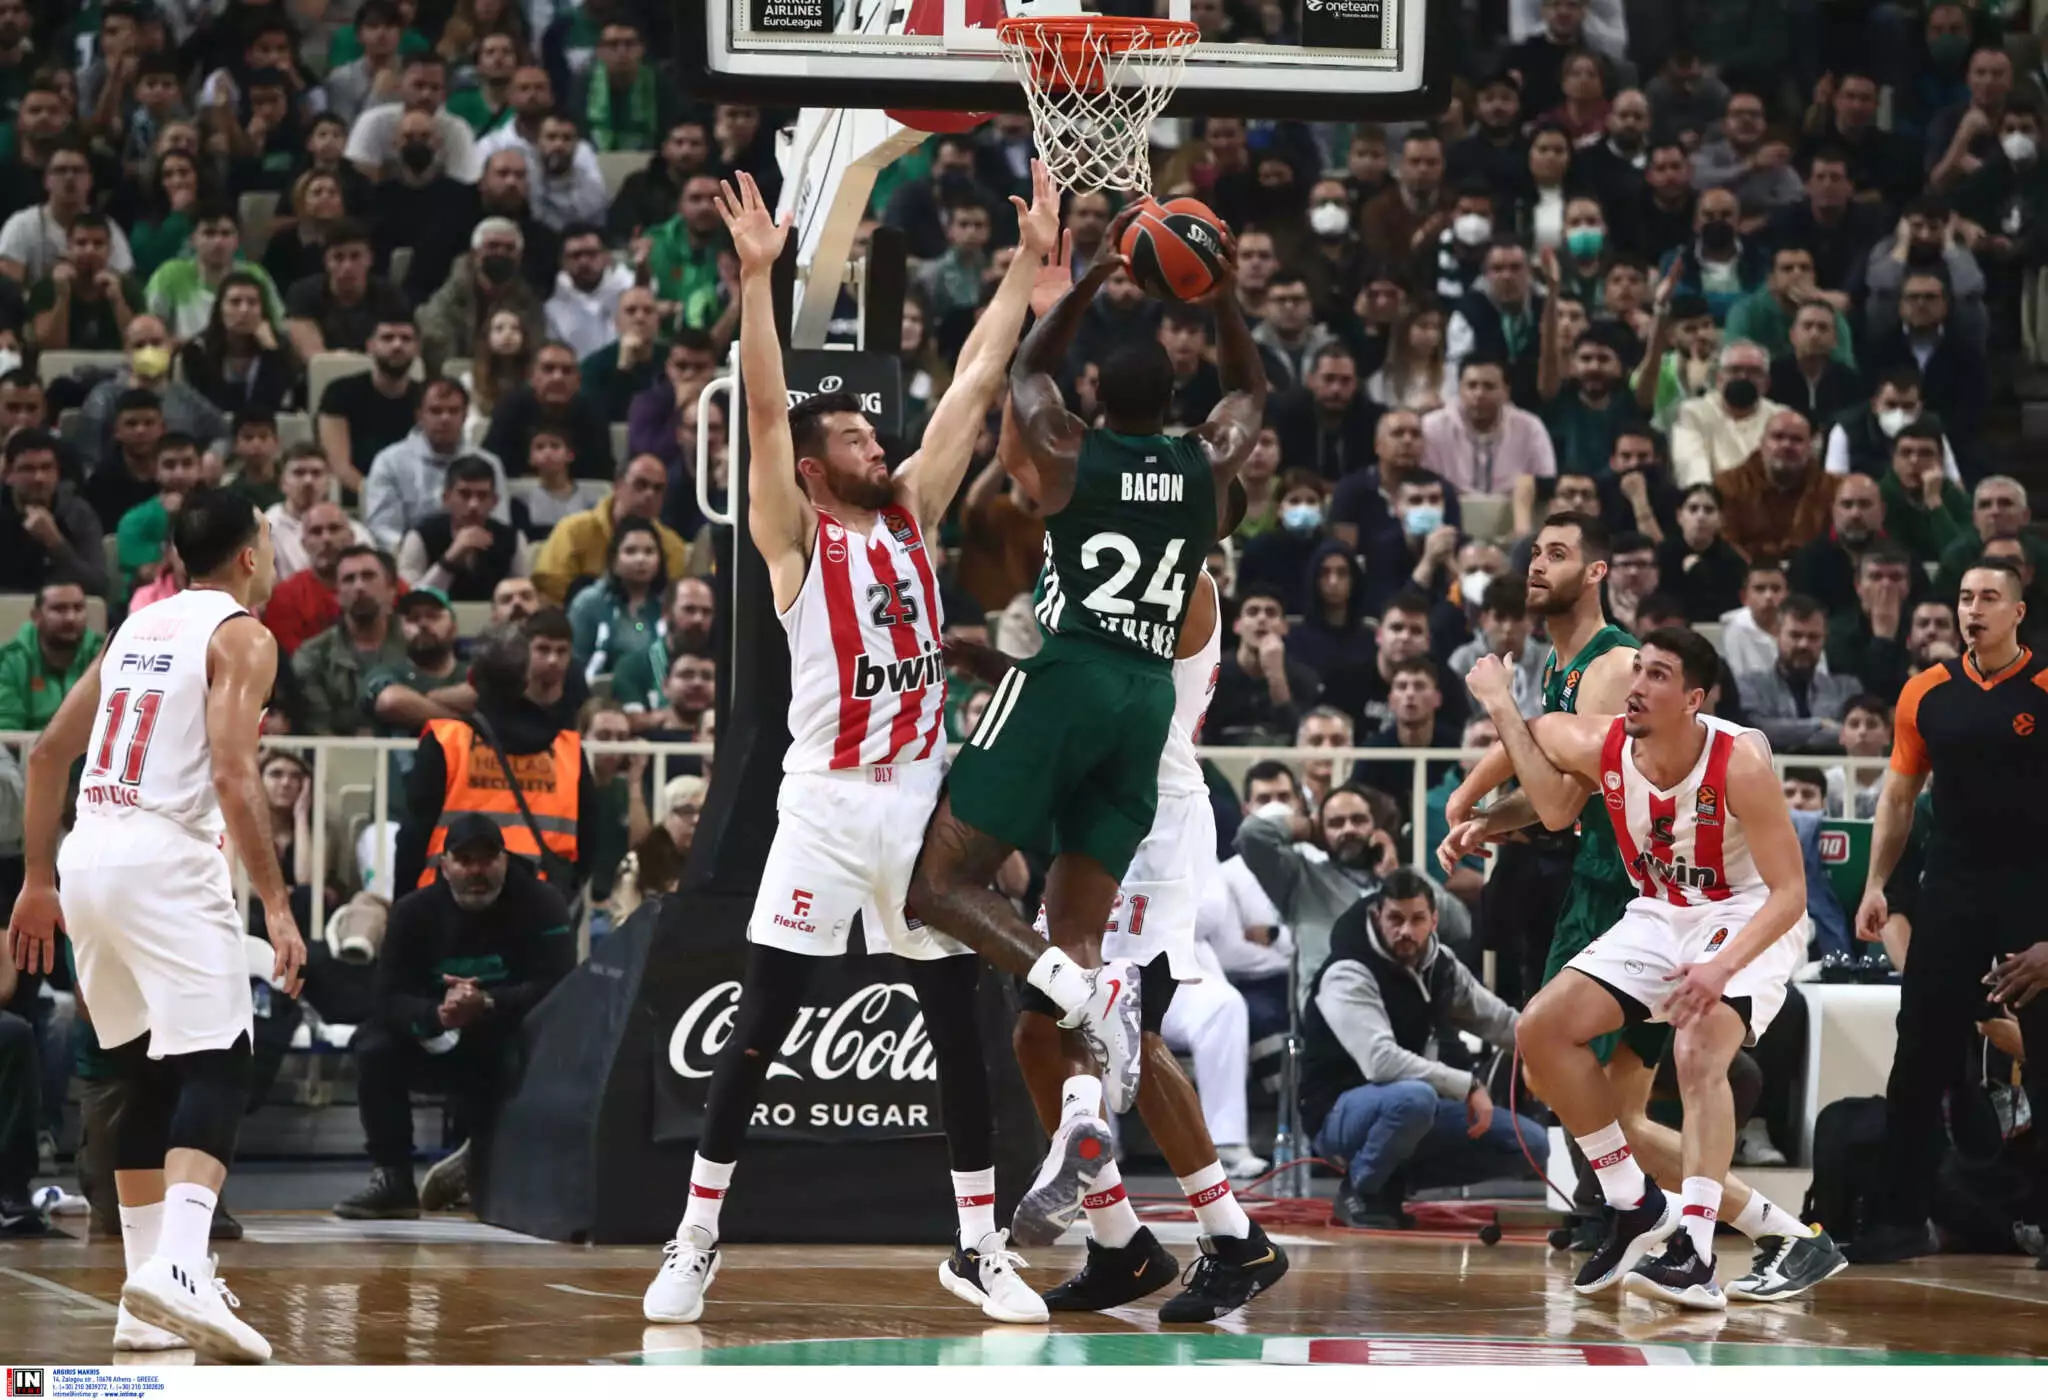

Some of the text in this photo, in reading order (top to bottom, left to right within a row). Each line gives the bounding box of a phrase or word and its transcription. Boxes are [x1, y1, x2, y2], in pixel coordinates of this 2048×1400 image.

[765, 5, 822, 16] AIRLINES
[1326, 2, 1379, 12] oneteam
[763, 17, 823, 29] EuroLeague
[1121, 472, 1183, 502] BACON
[1081, 531, 1186, 622] 24
[866, 579, 919, 627] 25
[120, 653, 174, 673] FMS
[87, 687, 165, 786] 11
[773, 914, 816, 933] FlexCar
[810, 1103, 928, 1127] SUGAR
[1598, 1149, 1629, 1168] GSA
[1084, 1195, 1116, 1207] GSA
[1199, 1185, 1226, 1203] GSA
